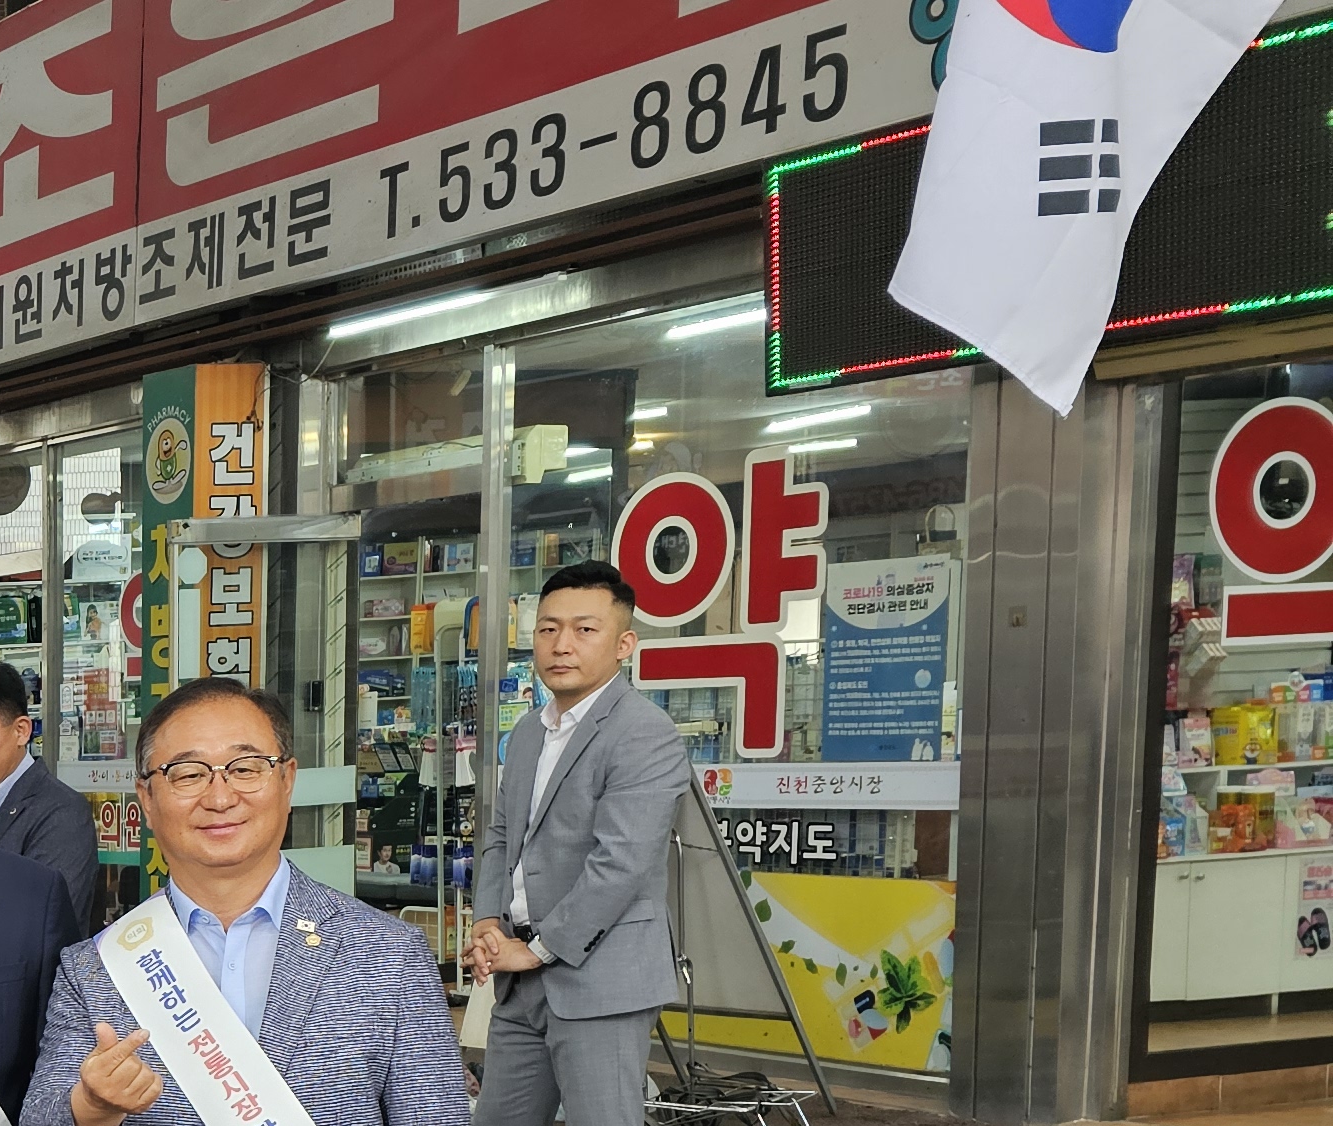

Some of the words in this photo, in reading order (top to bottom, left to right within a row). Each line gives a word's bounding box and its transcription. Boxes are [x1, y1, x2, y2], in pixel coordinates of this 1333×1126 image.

[380, 23, 848, 240] T.533-8845
[148, 405, 191, 432] PHARMACY
[613, 448, 828, 756] 약
[843, 586, 883, 600] 코로나19
[886, 582, 934, 596] 의심증상자
[847, 603, 885, 615] 진단검사
[888, 600, 907, 612] 관련
[910, 598, 928, 611] 안내
[776, 775, 883, 794] 진천중앙시장
[136, 949, 202, 1034] 함께하는
[187, 1028, 263, 1124] 전통시장
